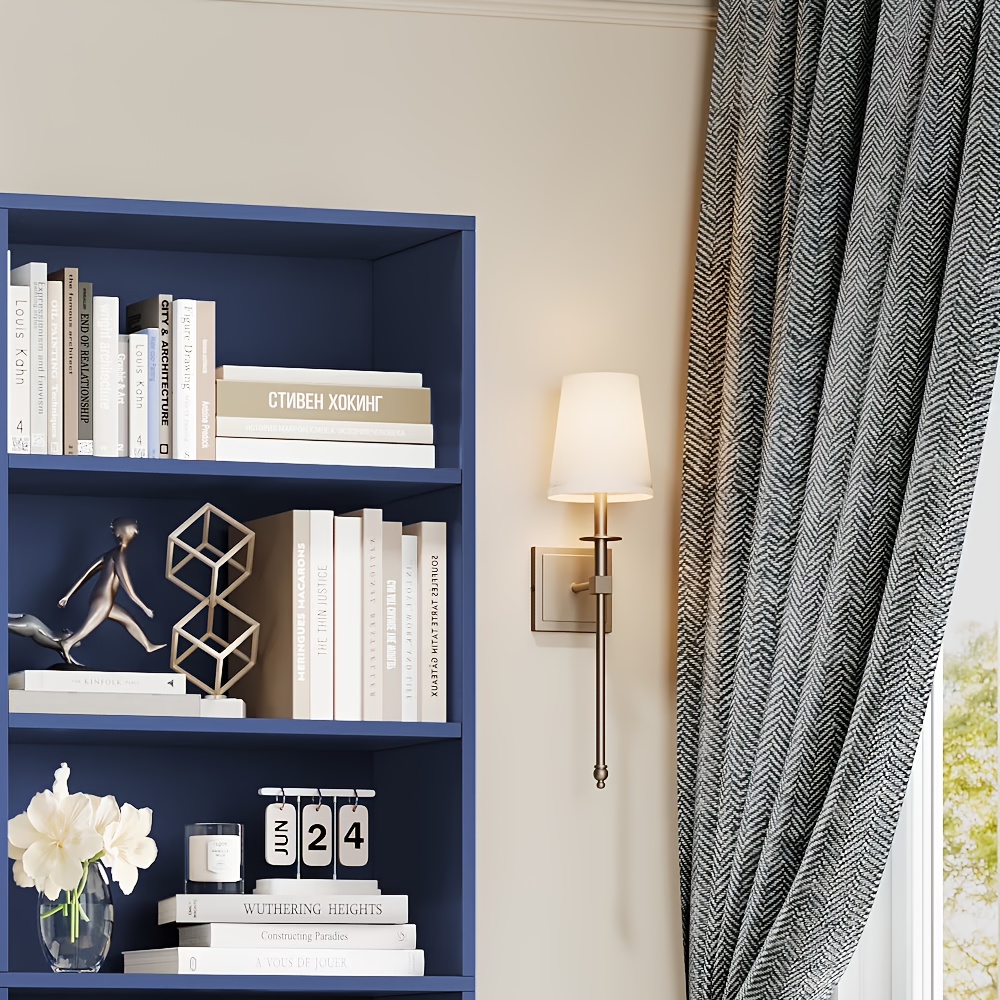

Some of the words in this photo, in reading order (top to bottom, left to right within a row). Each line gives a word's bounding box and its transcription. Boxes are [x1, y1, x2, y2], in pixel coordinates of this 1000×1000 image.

[15, 300, 28, 339] Louis
[50, 299, 59, 320] OIL
[80, 313, 90, 334] END
[98, 304, 113, 339] wright
[161, 299, 169, 325] CITY
[181, 305, 193, 341] Figure
[80, 335, 90, 348] OF
[161, 328, 169, 336] &
[15, 348, 28, 386] Kahn
[37, 354, 46, 372] and
[50, 323, 59, 379] PAINTING
[135, 344, 146, 374] Louis
[99, 342, 113, 411] architecture
[161, 340, 169, 427] ARCHITECTURE
[181, 344, 193, 391] Drawing
[37, 375, 46, 415] Fauvism
[80, 349, 90, 424] REALATIONSHIP
[135, 381, 146, 409] Kahn
[268, 391, 324, 410] СТИВЕН
[328, 393, 384, 413] ХОКИНГ
[16, 420, 24, 434] 4
[49, 383, 59, 439] Techniques
[296, 542, 306, 609] MACARONS
[316, 564, 328, 607] JUSTICE
[316, 610, 328, 633] THIN
[296, 613, 306, 682] MERINGUES
[316, 637, 328, 656] THE
[274, 820, 289, 856] JUN
[243, 902, 321, 916] WUTHERING
[328, 902, 383, 916] HEIGHTS
[260, 930, 313, 943] Constructing
[314, 931, 349, 942] Paradies
[266, 956, 294, 968] VOUS
[296, 957, 311, 968] DE
[314, 956, 348, 970] JOUER
